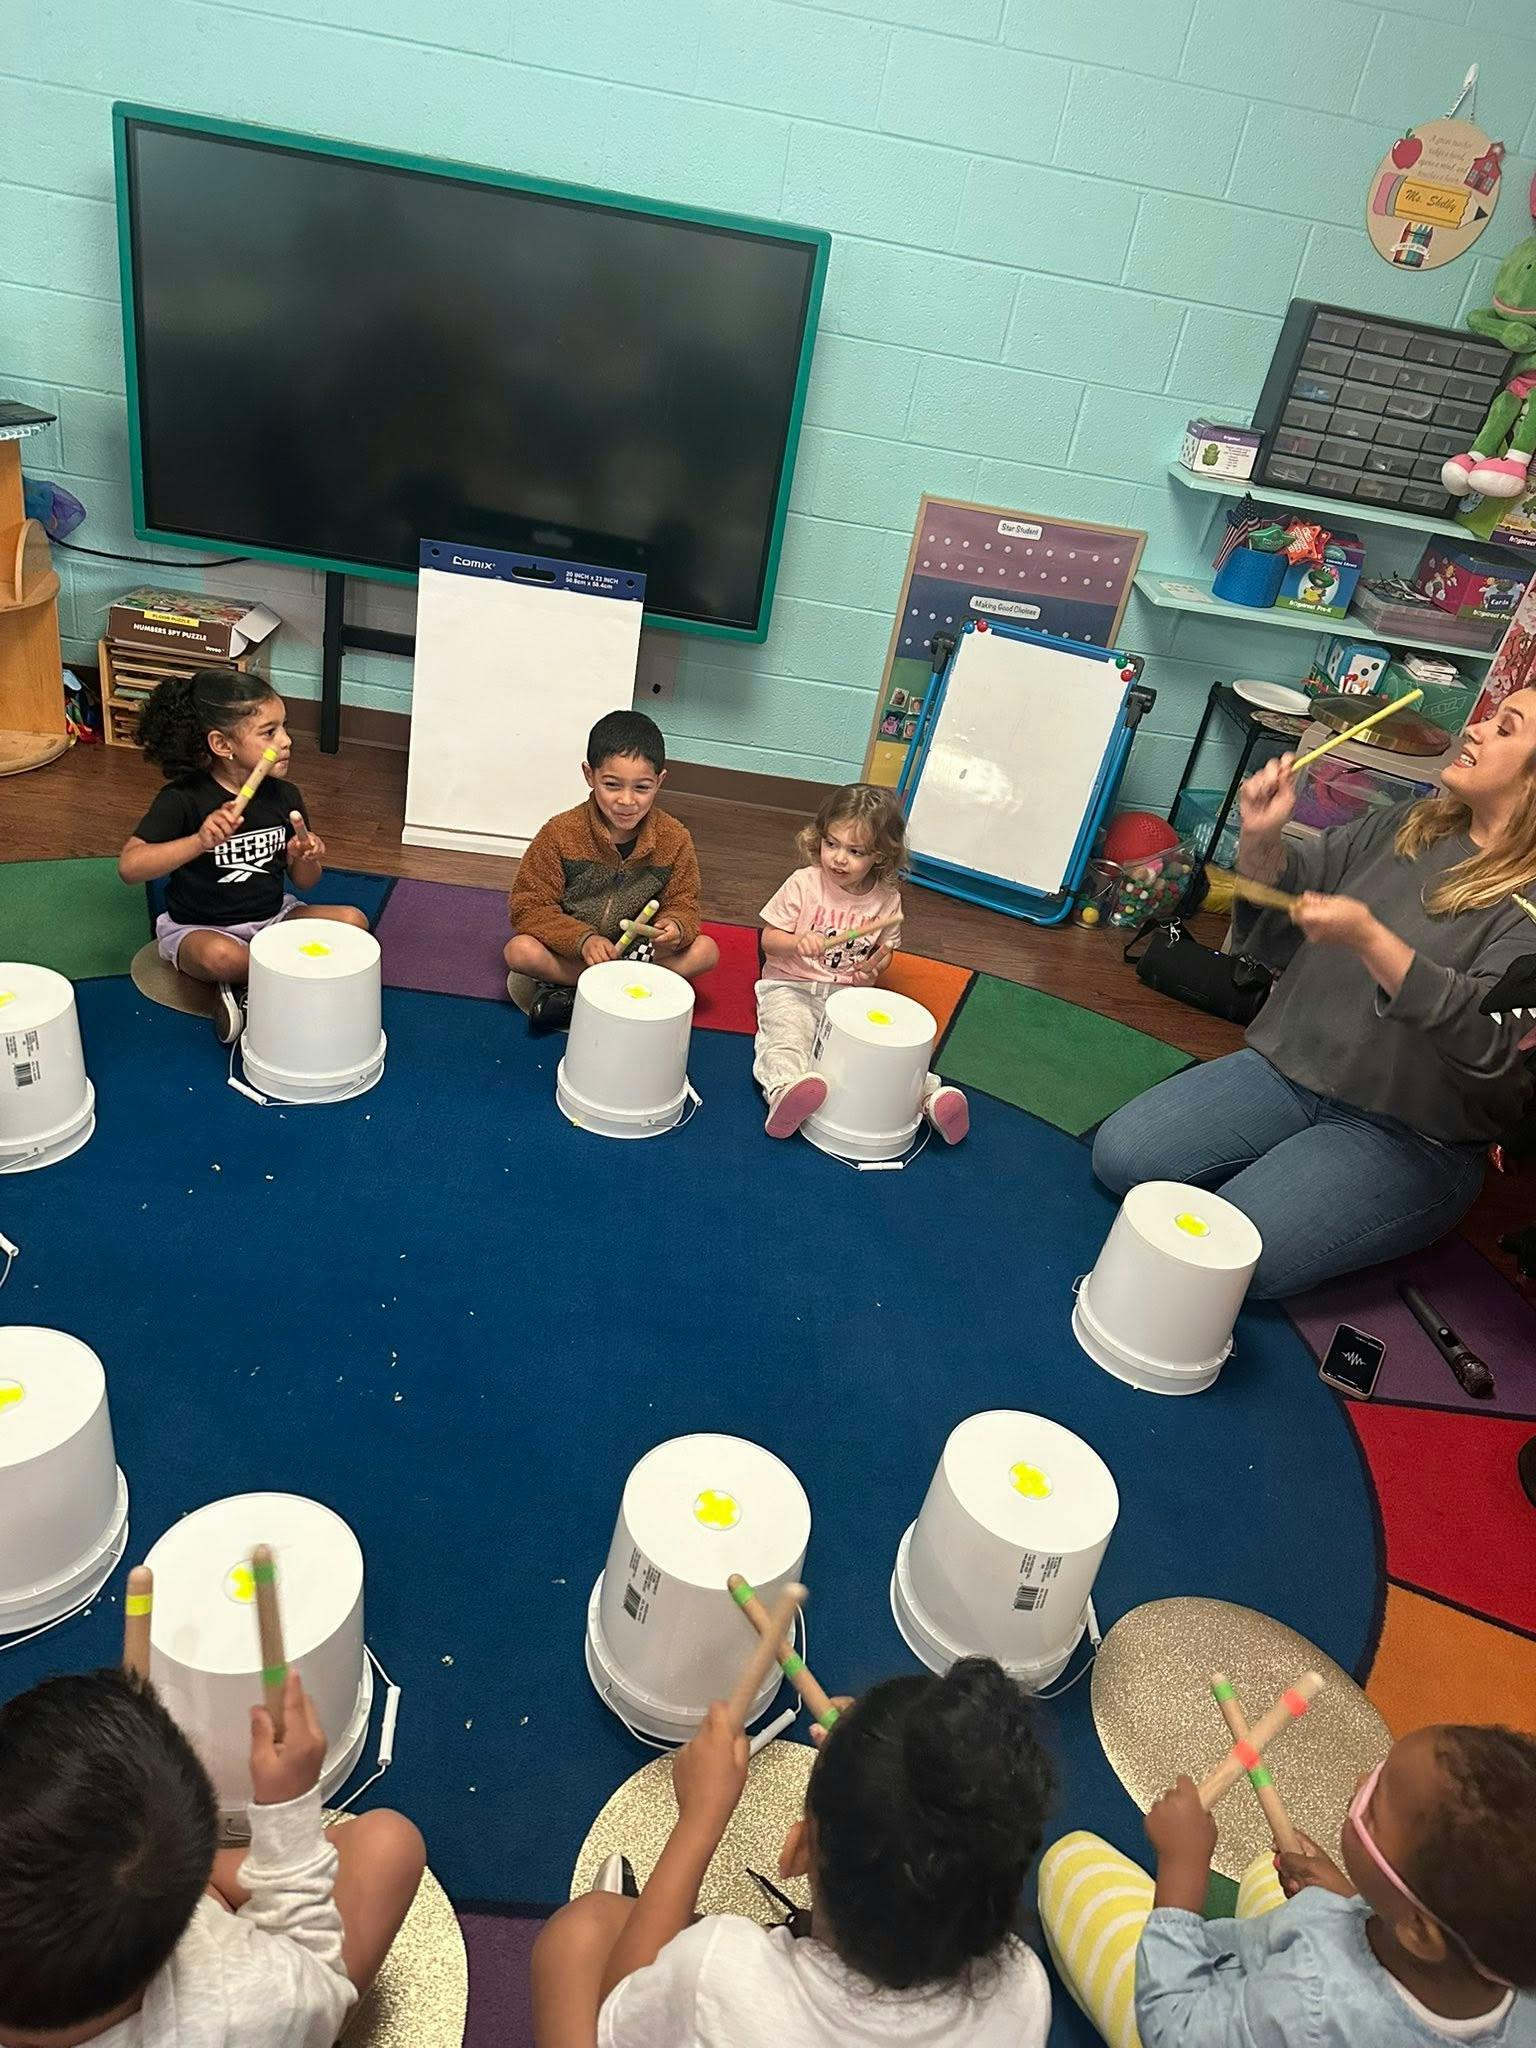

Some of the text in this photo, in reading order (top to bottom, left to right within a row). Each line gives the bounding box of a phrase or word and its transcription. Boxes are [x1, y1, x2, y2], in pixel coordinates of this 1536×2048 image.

[1405, 189, 1457, 213] Ms. Shelby
[1002, 523, 1039, 535] Star Student
[574, 572, 589, 580] INCH
[603, 576, 619, 584] INCH
[975, 600, 1037, 616] Making Good Choices
[133, 623, 207, 641] NUMBERS SPY PUZZLE
